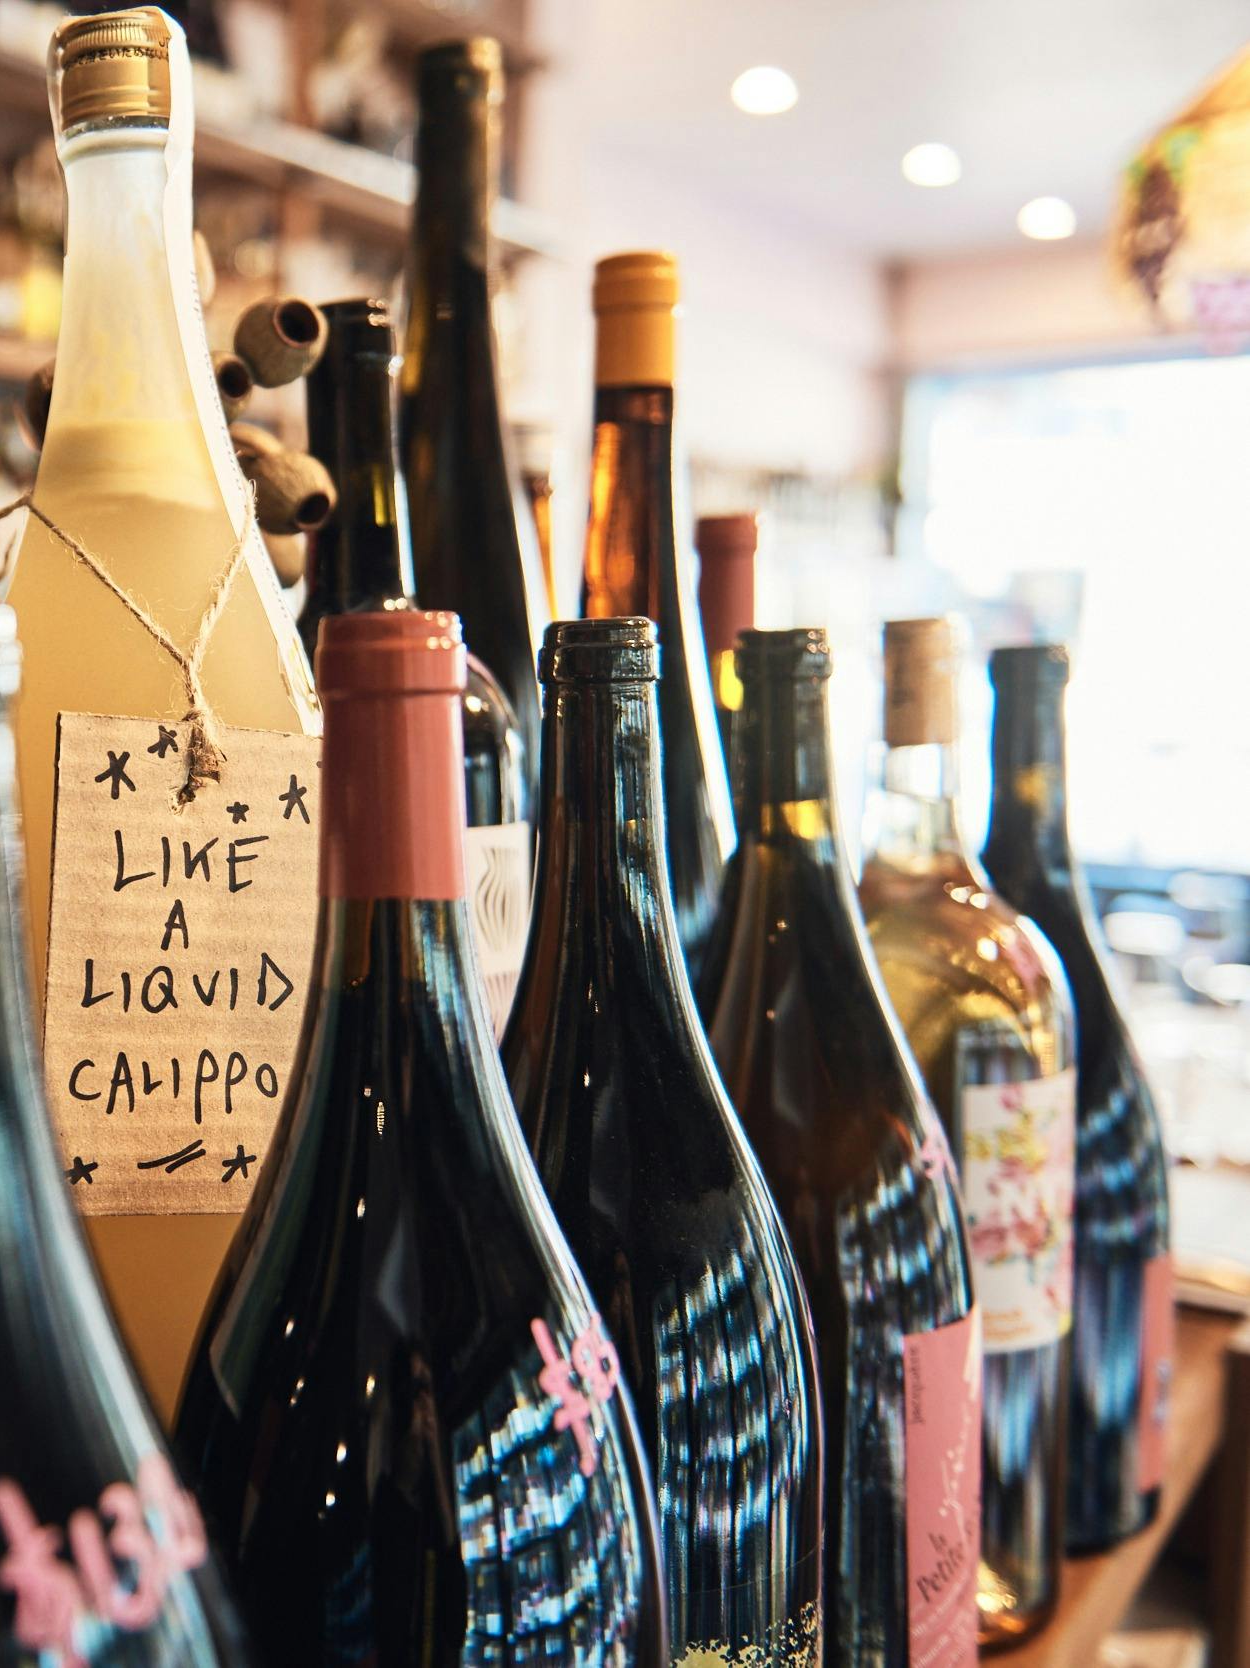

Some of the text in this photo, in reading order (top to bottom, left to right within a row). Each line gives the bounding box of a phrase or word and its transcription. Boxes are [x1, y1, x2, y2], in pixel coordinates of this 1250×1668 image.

[113, 829, 270, 893] LIKE
[160, 898, 190, 951] A
[67, 1048, 279, 1125] CALIPPO
